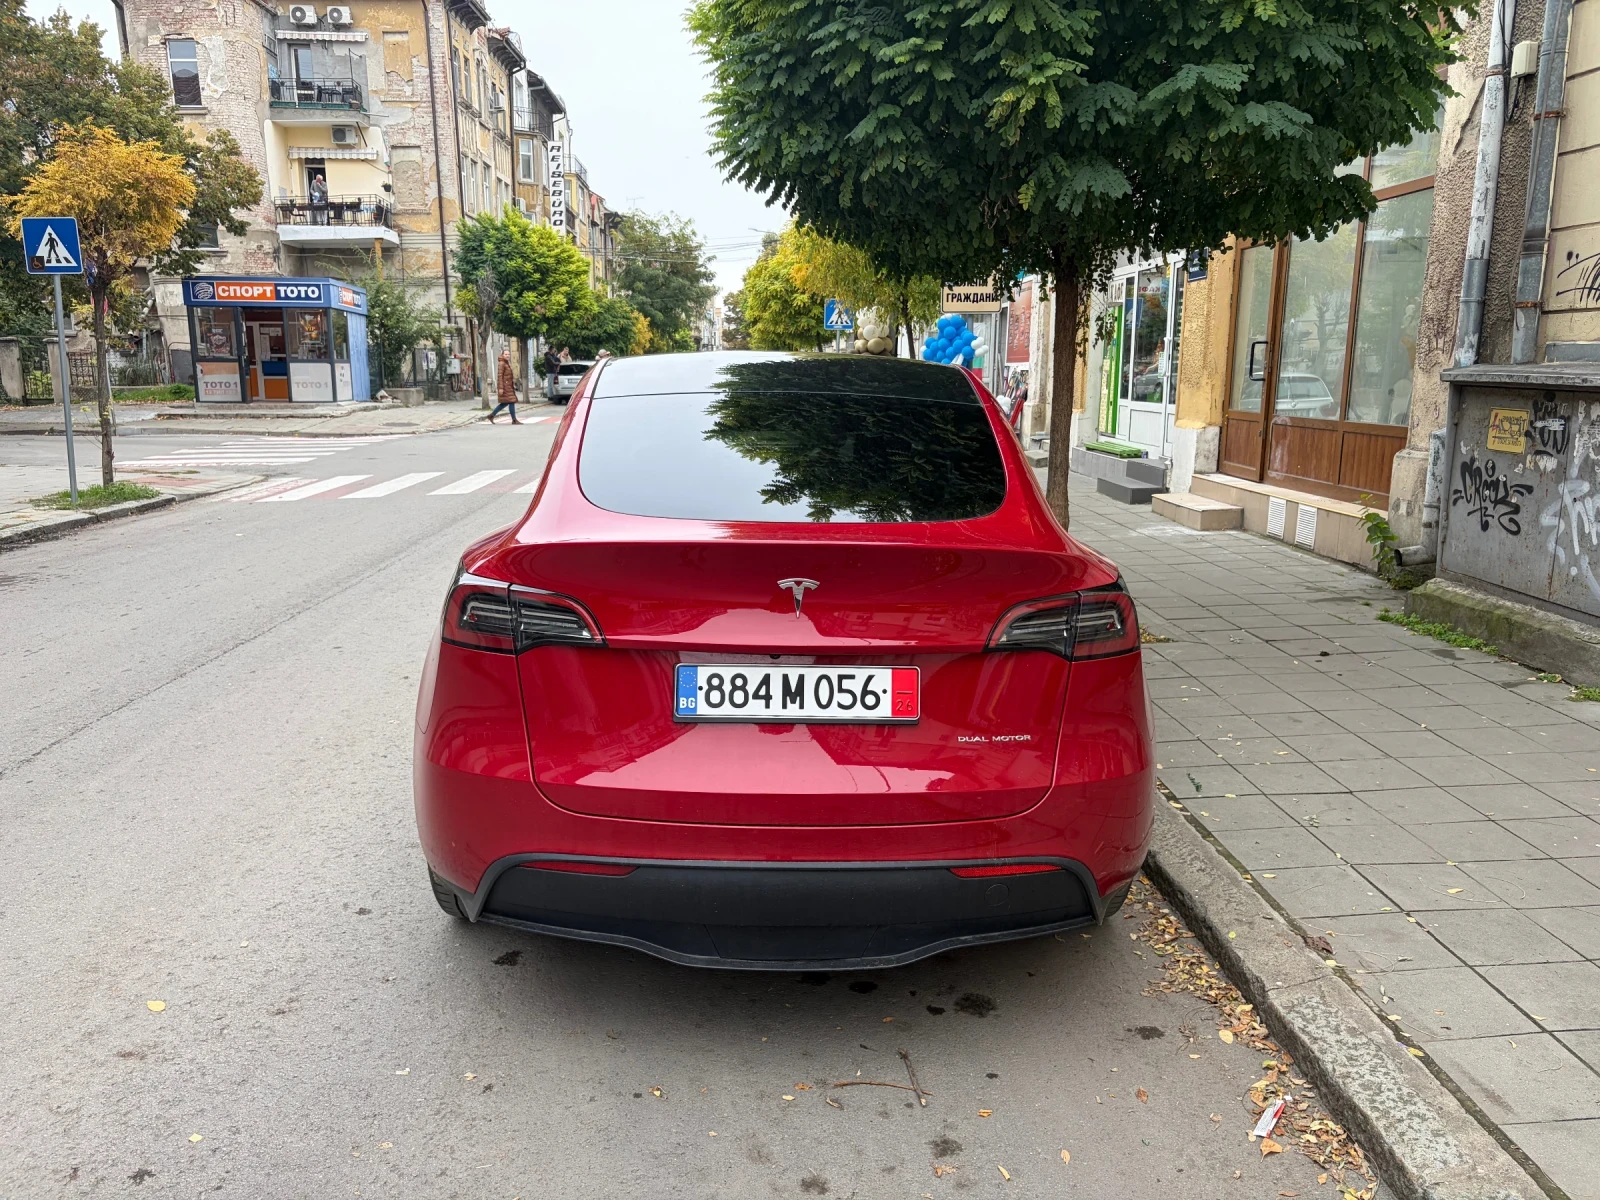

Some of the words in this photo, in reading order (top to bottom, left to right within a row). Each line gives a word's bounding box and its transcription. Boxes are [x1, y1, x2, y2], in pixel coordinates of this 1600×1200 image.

[549, 145, 563, 226] REISEBÜRO
[217, 285, 274, 298] СПОРТ
[277, 286, 320, 298] ТОТО
[203, 381, 231, 389] ТОТО
[233, 381, 238, 389] 1
[704, 672, 773, 710] 884
[781, 673, 805, 710] M
[813, 674, 881, 711] 056
[679, 697, 696, 709] BG
[895, 699, 914, 712] 26
[991, 734, 1032, 742] MOTOR
